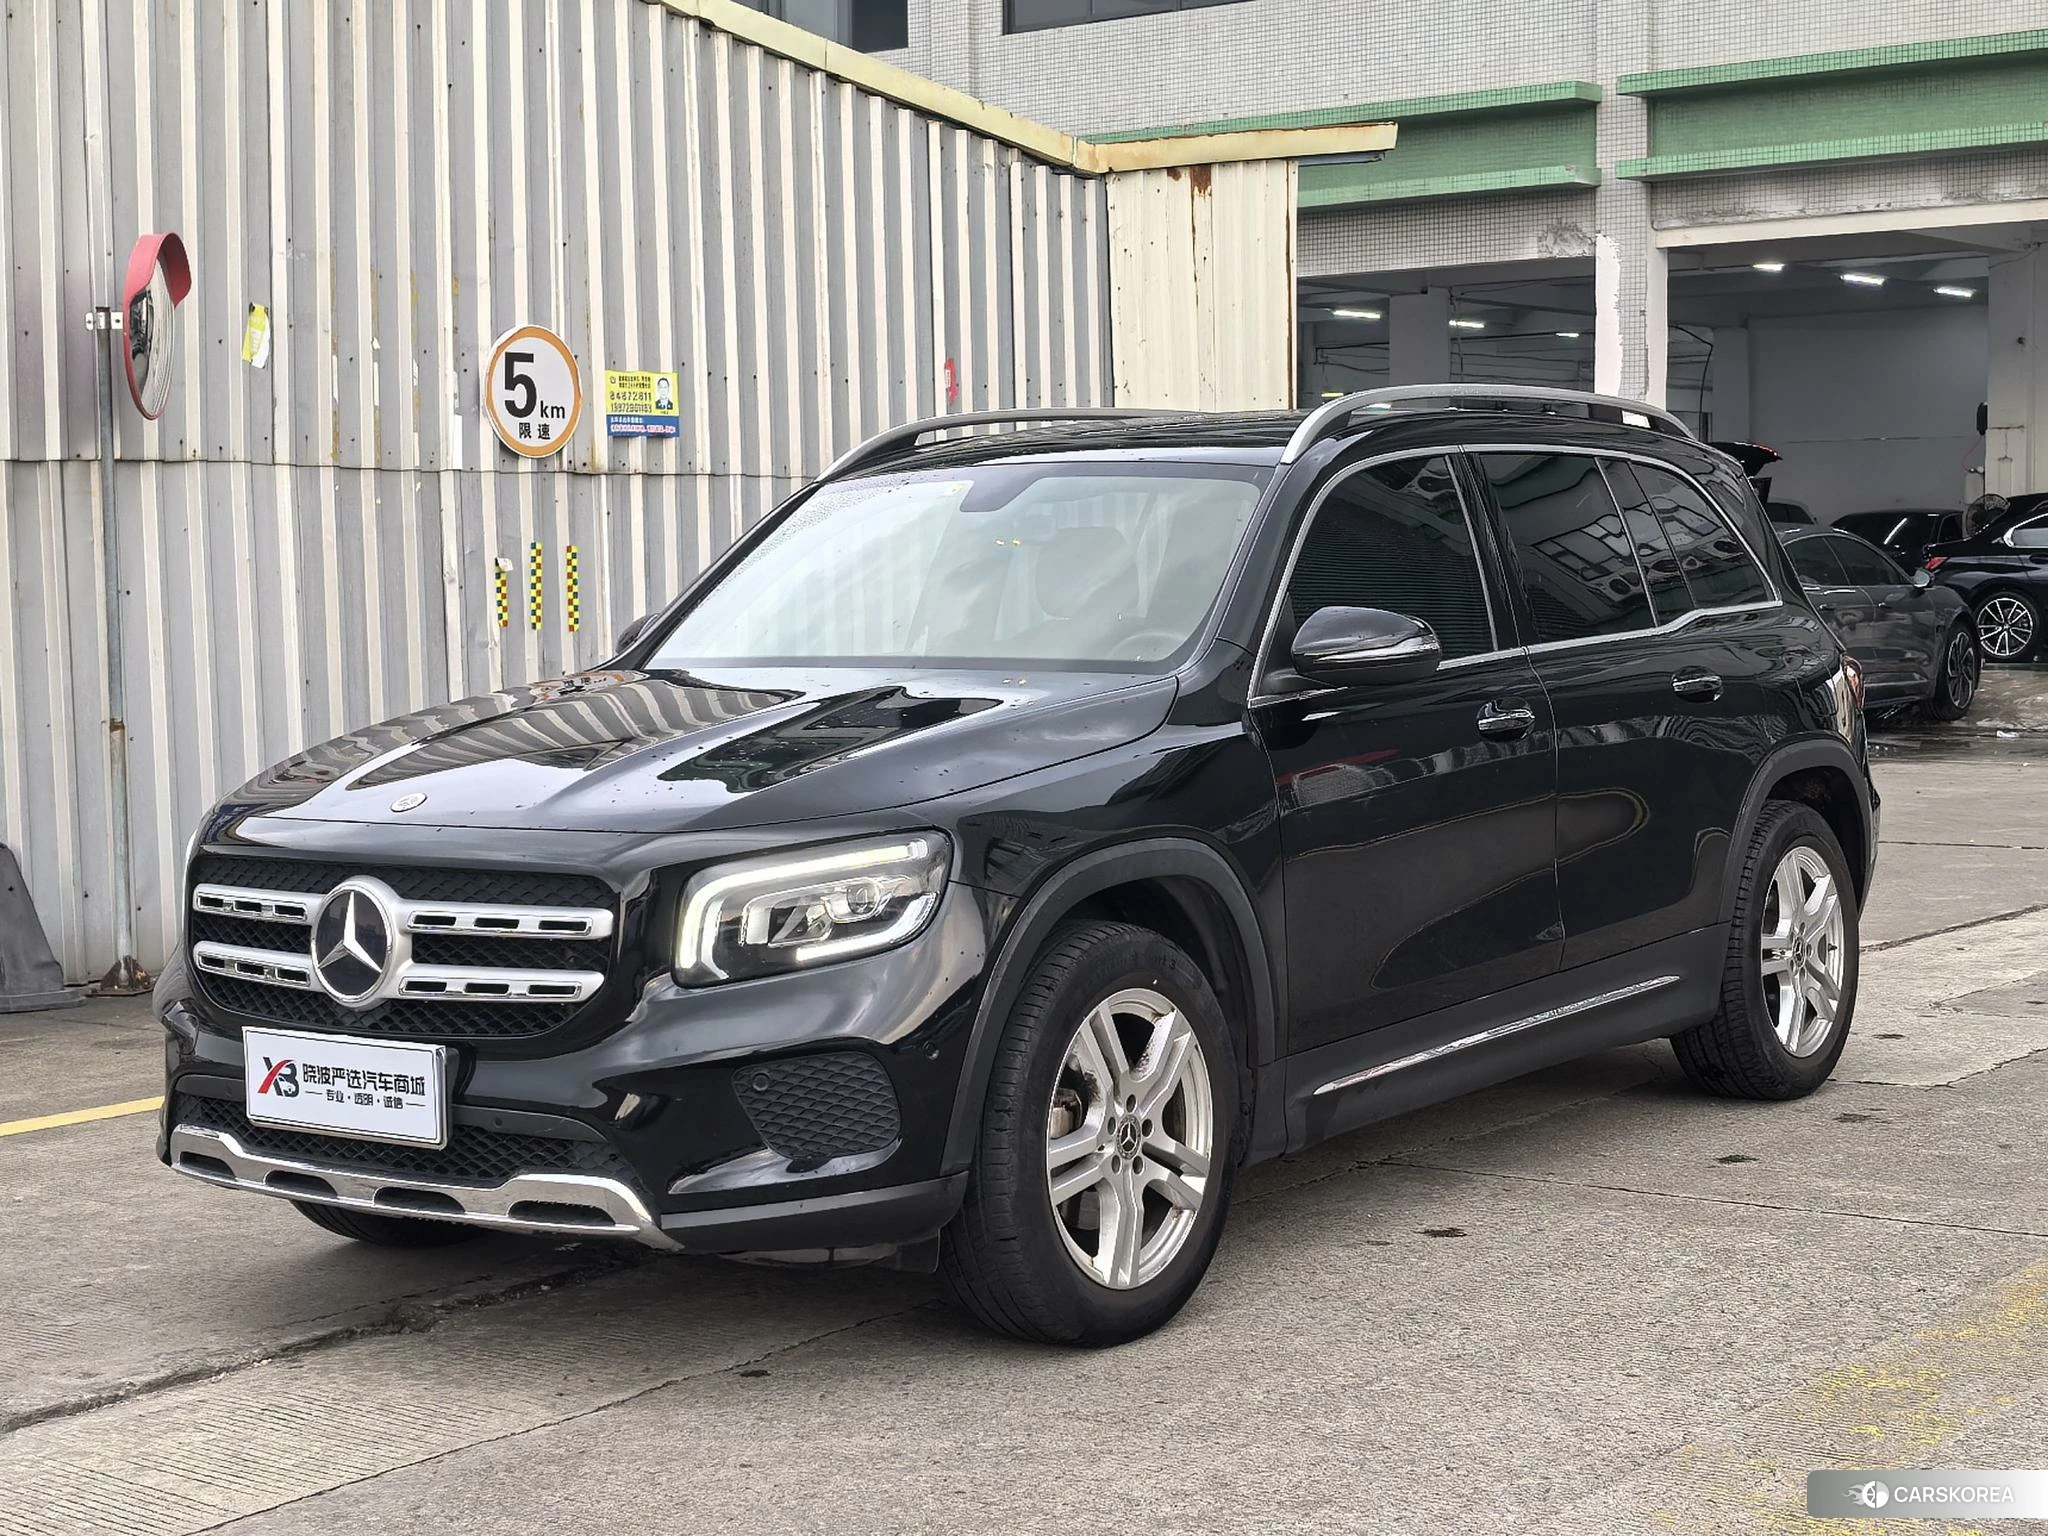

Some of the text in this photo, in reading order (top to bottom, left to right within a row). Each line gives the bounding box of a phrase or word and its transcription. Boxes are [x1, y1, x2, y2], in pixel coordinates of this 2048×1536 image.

[504, 351, 566, 420] 5 km
[518, 422, 551, 440] 限速
[302, 1063, 426, 1097] 晓波严选汽车商城
